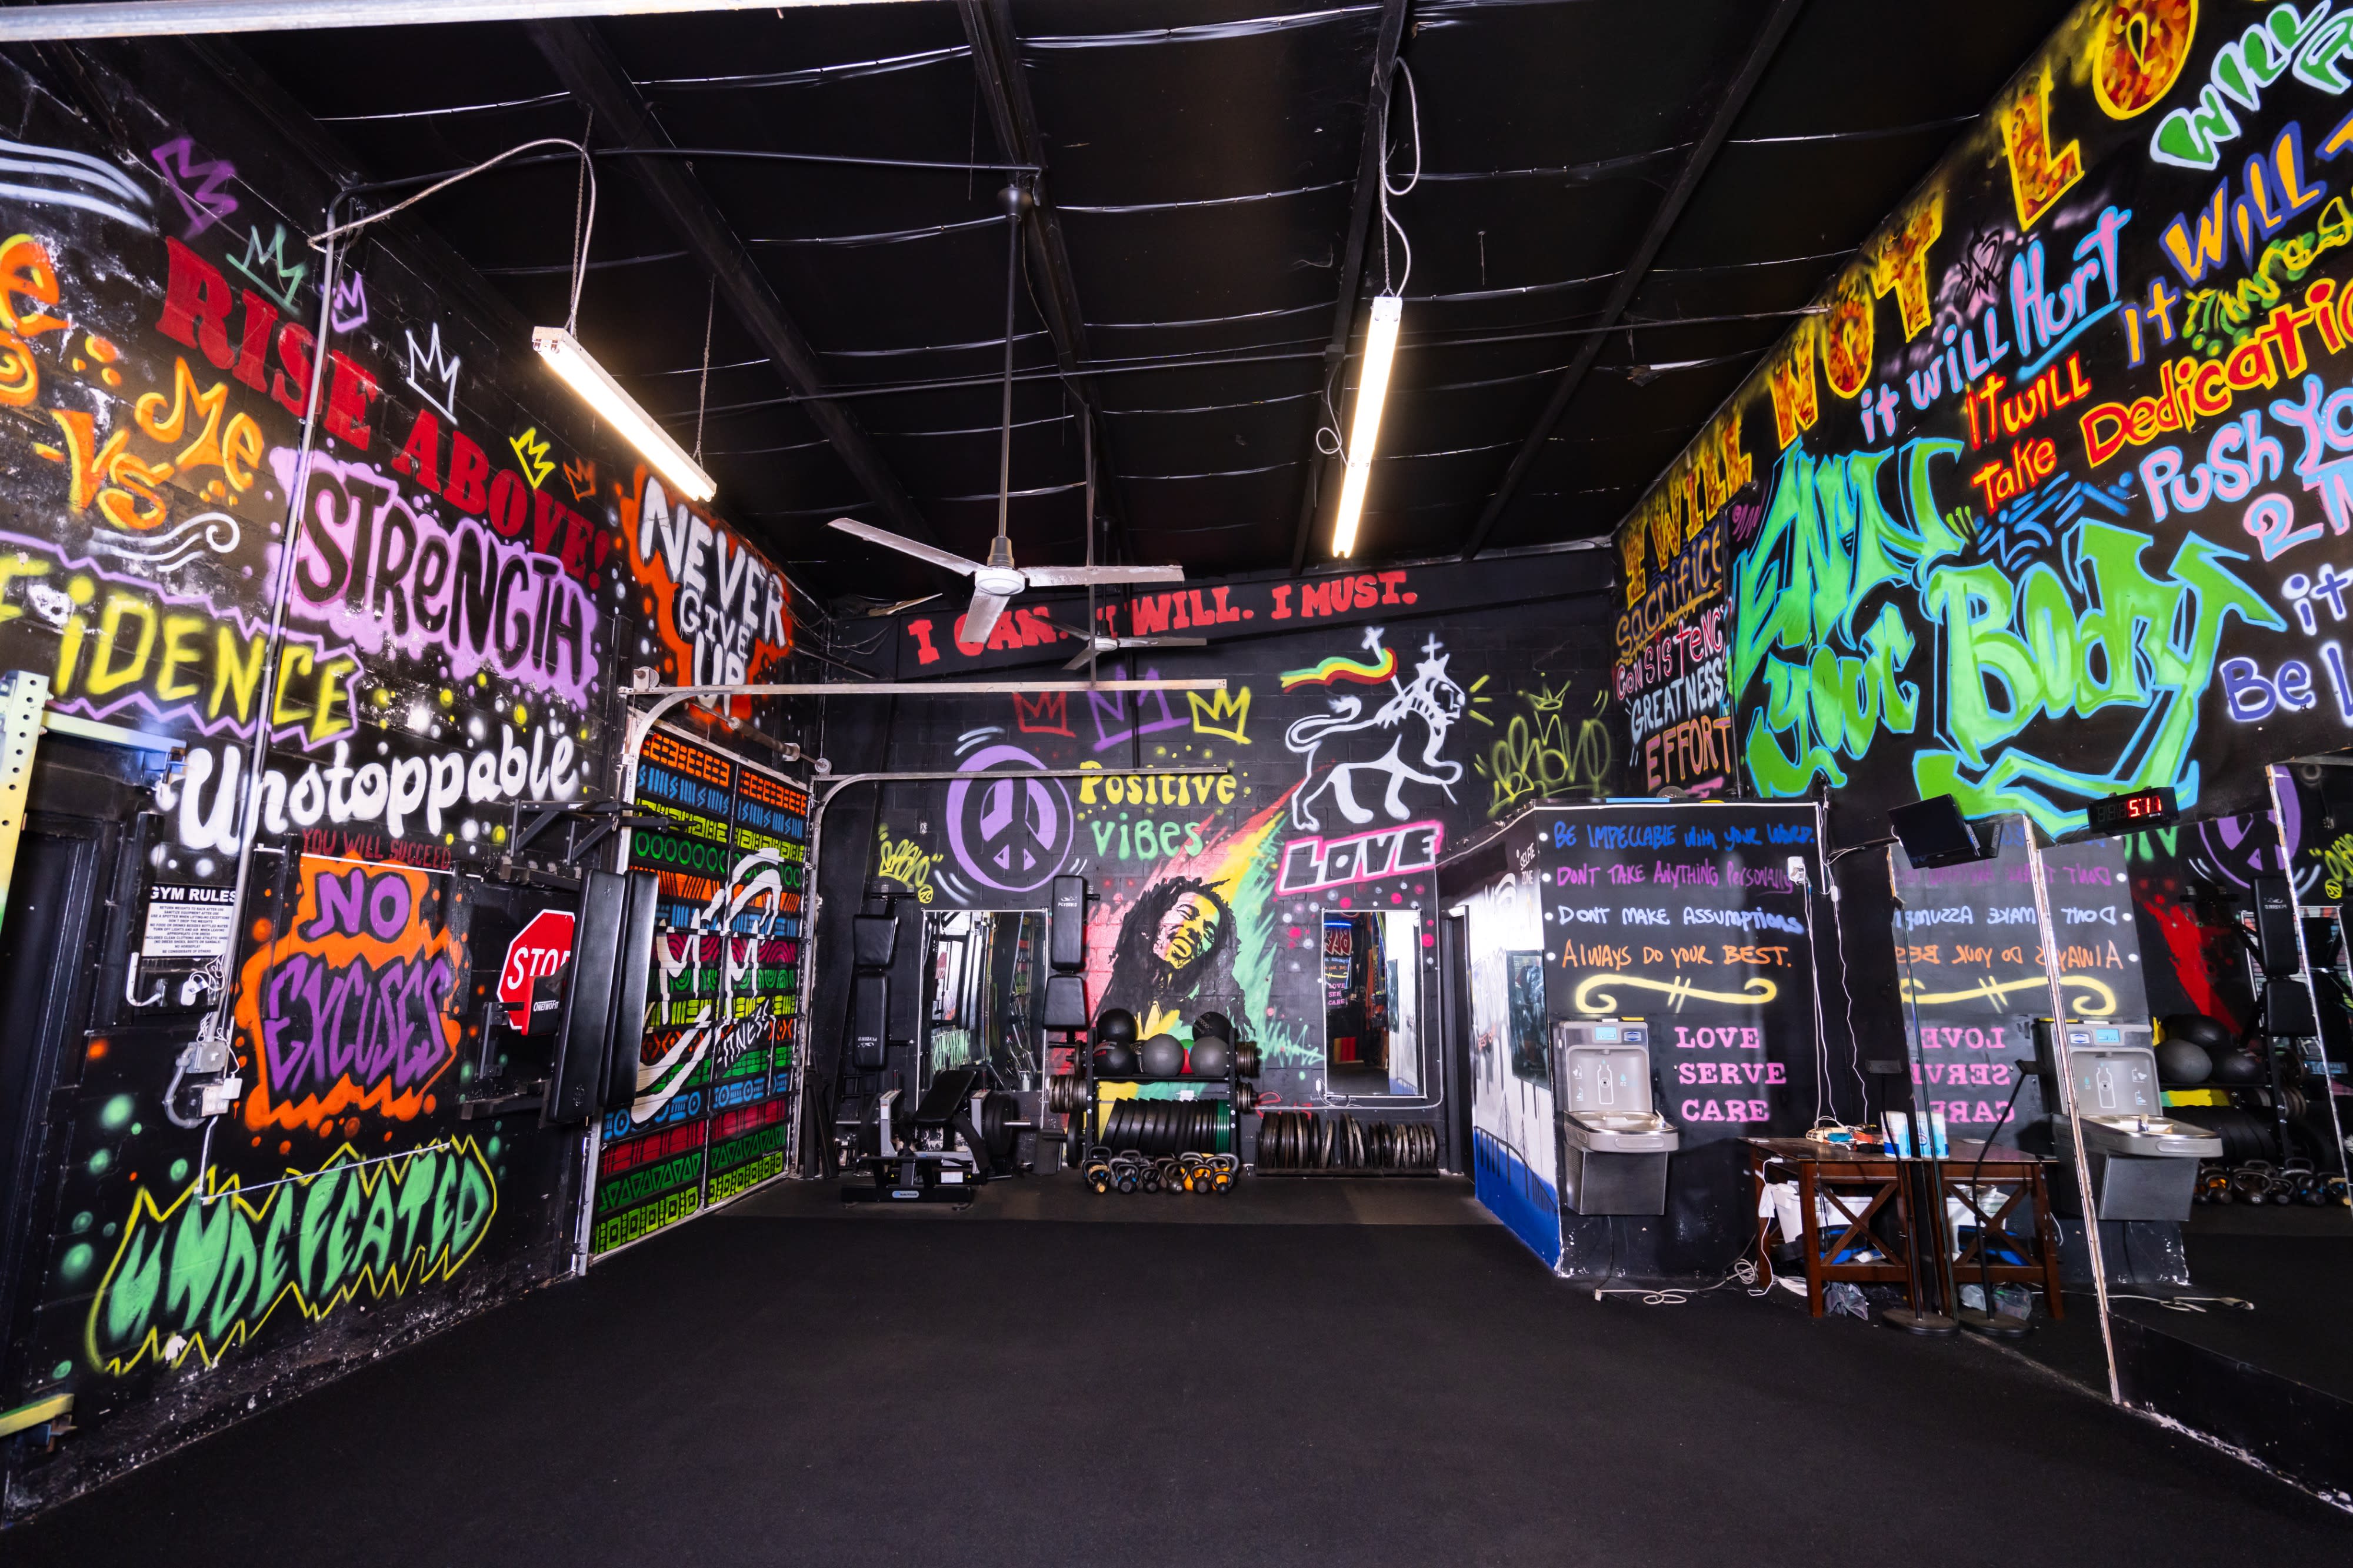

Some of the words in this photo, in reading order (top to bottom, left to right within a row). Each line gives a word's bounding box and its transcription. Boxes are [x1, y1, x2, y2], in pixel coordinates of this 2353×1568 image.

[1767, 191, 1943, 450] NOT
[156, 236, 377, 452] RISE
[391, 408, 611, 589] ABOVE!
[640, 476, 786, 647] NEVER
[680, 589, 750, 659] GIVE
[907, 619, 940, 665] I
[1128, 586, 1254, 636] WILL.
[1271, 585, 1292, 620] I
[1300, 571, 1418, 618] MUST.
[694, 630, 746, 717] UP
[1631, 656, 1724, 745] GREATNESS
[1078, 760, 1237, 806] Positive
[1645, 715, 1731, 791] EFFORT
[156, 726, 580, 855] Unstoppable
[302, 828, 336, 856] YOU
[343, 830, 384, 859] WILL
[389, 838, 452, 870] SUCCEED
[1279, 824, 1440, 893] LOVE
[1519, 842, 1536, 871] SELFIE
[1554, 820, 1577, 850] BE
[189, 888, 236, 903] RULES
[306, 870, 412, 940] NO
[1521, 870, 1534, 885] ZONE
[1607, 863, 1646, 885] TAKE
[1622, 907, 1671, 926] MAKE
[1722, 944, 1792, 968] BEST.
[263, 953, 449, 1092] EXCUSES
[1673, 1025, 1760, 1049] LOVE
[1678, 1062, 1787, 1085] SERVE
[1681, 1098, 1770, 1123] CARE
[105, 1148, 491, 1342] UNDEFEATED
